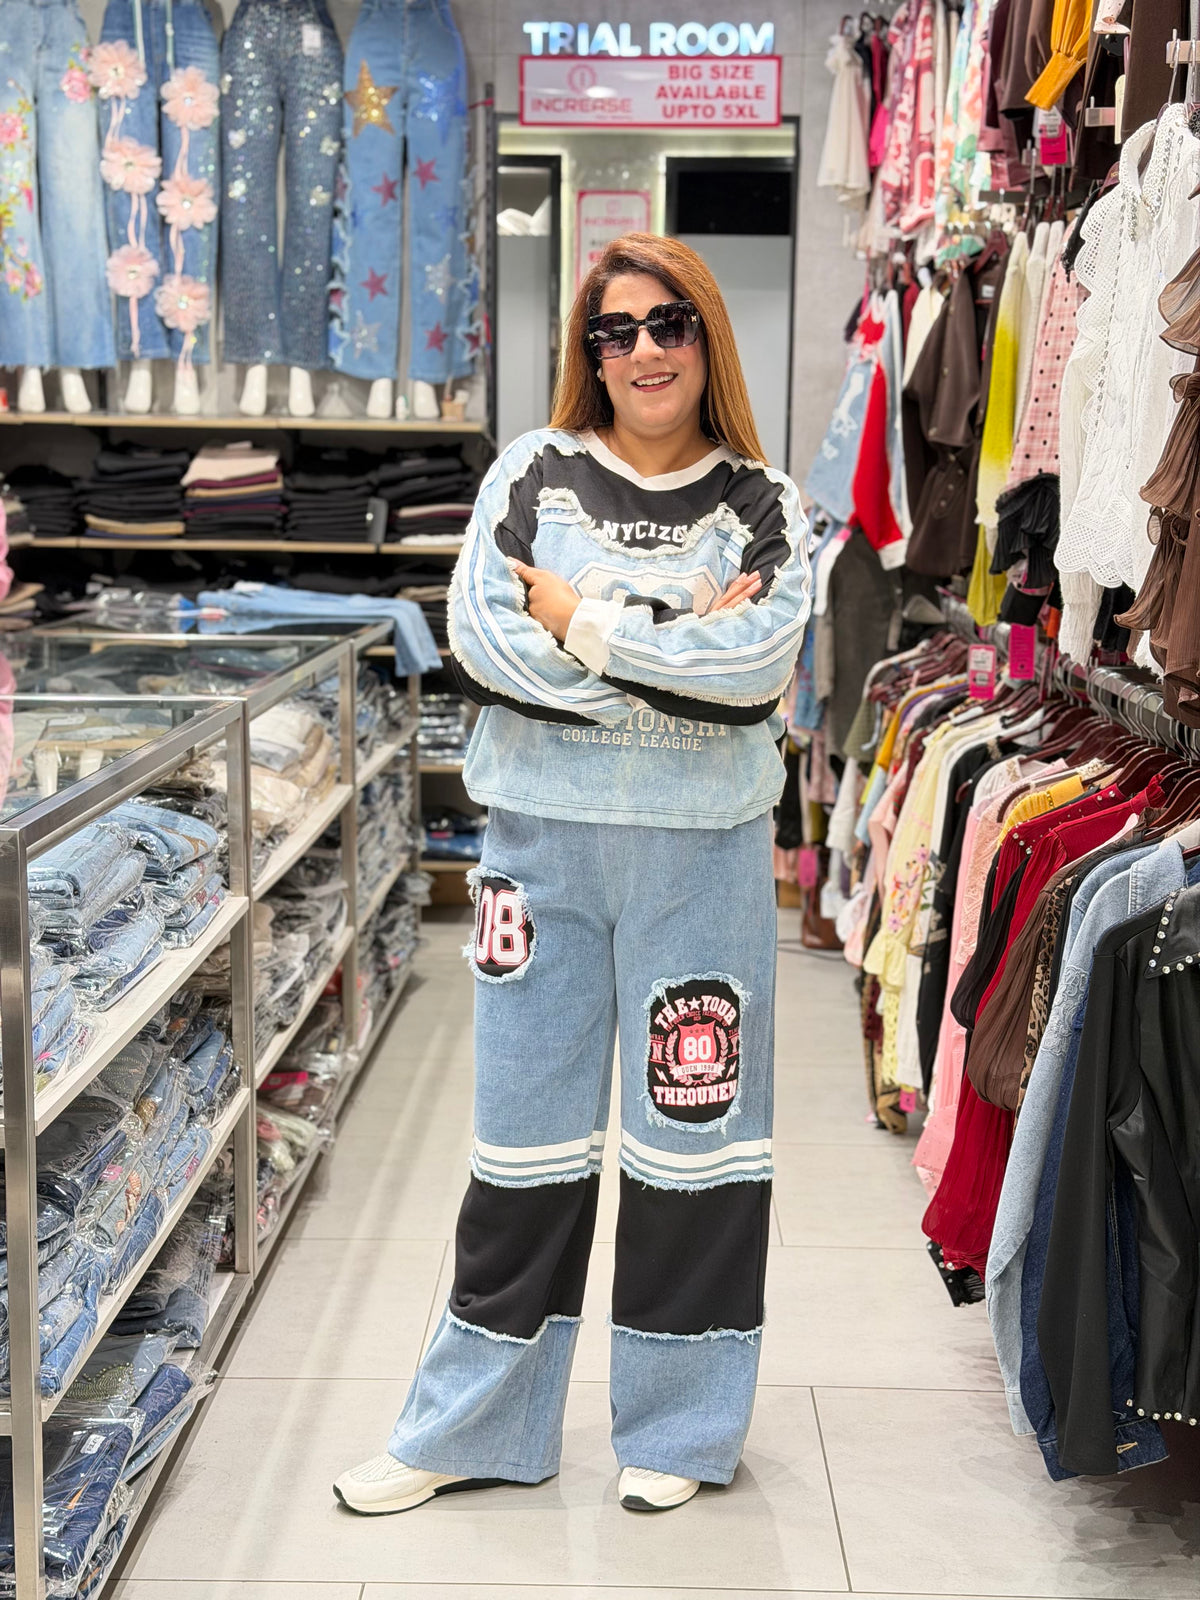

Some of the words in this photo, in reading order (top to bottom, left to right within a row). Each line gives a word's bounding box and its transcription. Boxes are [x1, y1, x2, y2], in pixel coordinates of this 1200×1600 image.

[523, 22, 641, 56] TRIAL
[650, 22, 774, 56] ROOM
[668, 65, 702, 80] BIG
[710, 65, 754, 80] SIZE
[656, 85, 766, 99] AVAILABLE
[531, 98, 632, 113] INCREASE
[662, 104, 716, 118] UPTO
[723, 104, 759, 118] 5XL
[562, 728, 632, 746] COLLEGE
[640, 733, 702, 751] LEAGUE
[654, 997, 689, 1031] THE
[701, 995, 737, 1026] YOUR
[683, 1035, 711, 1061] 80
